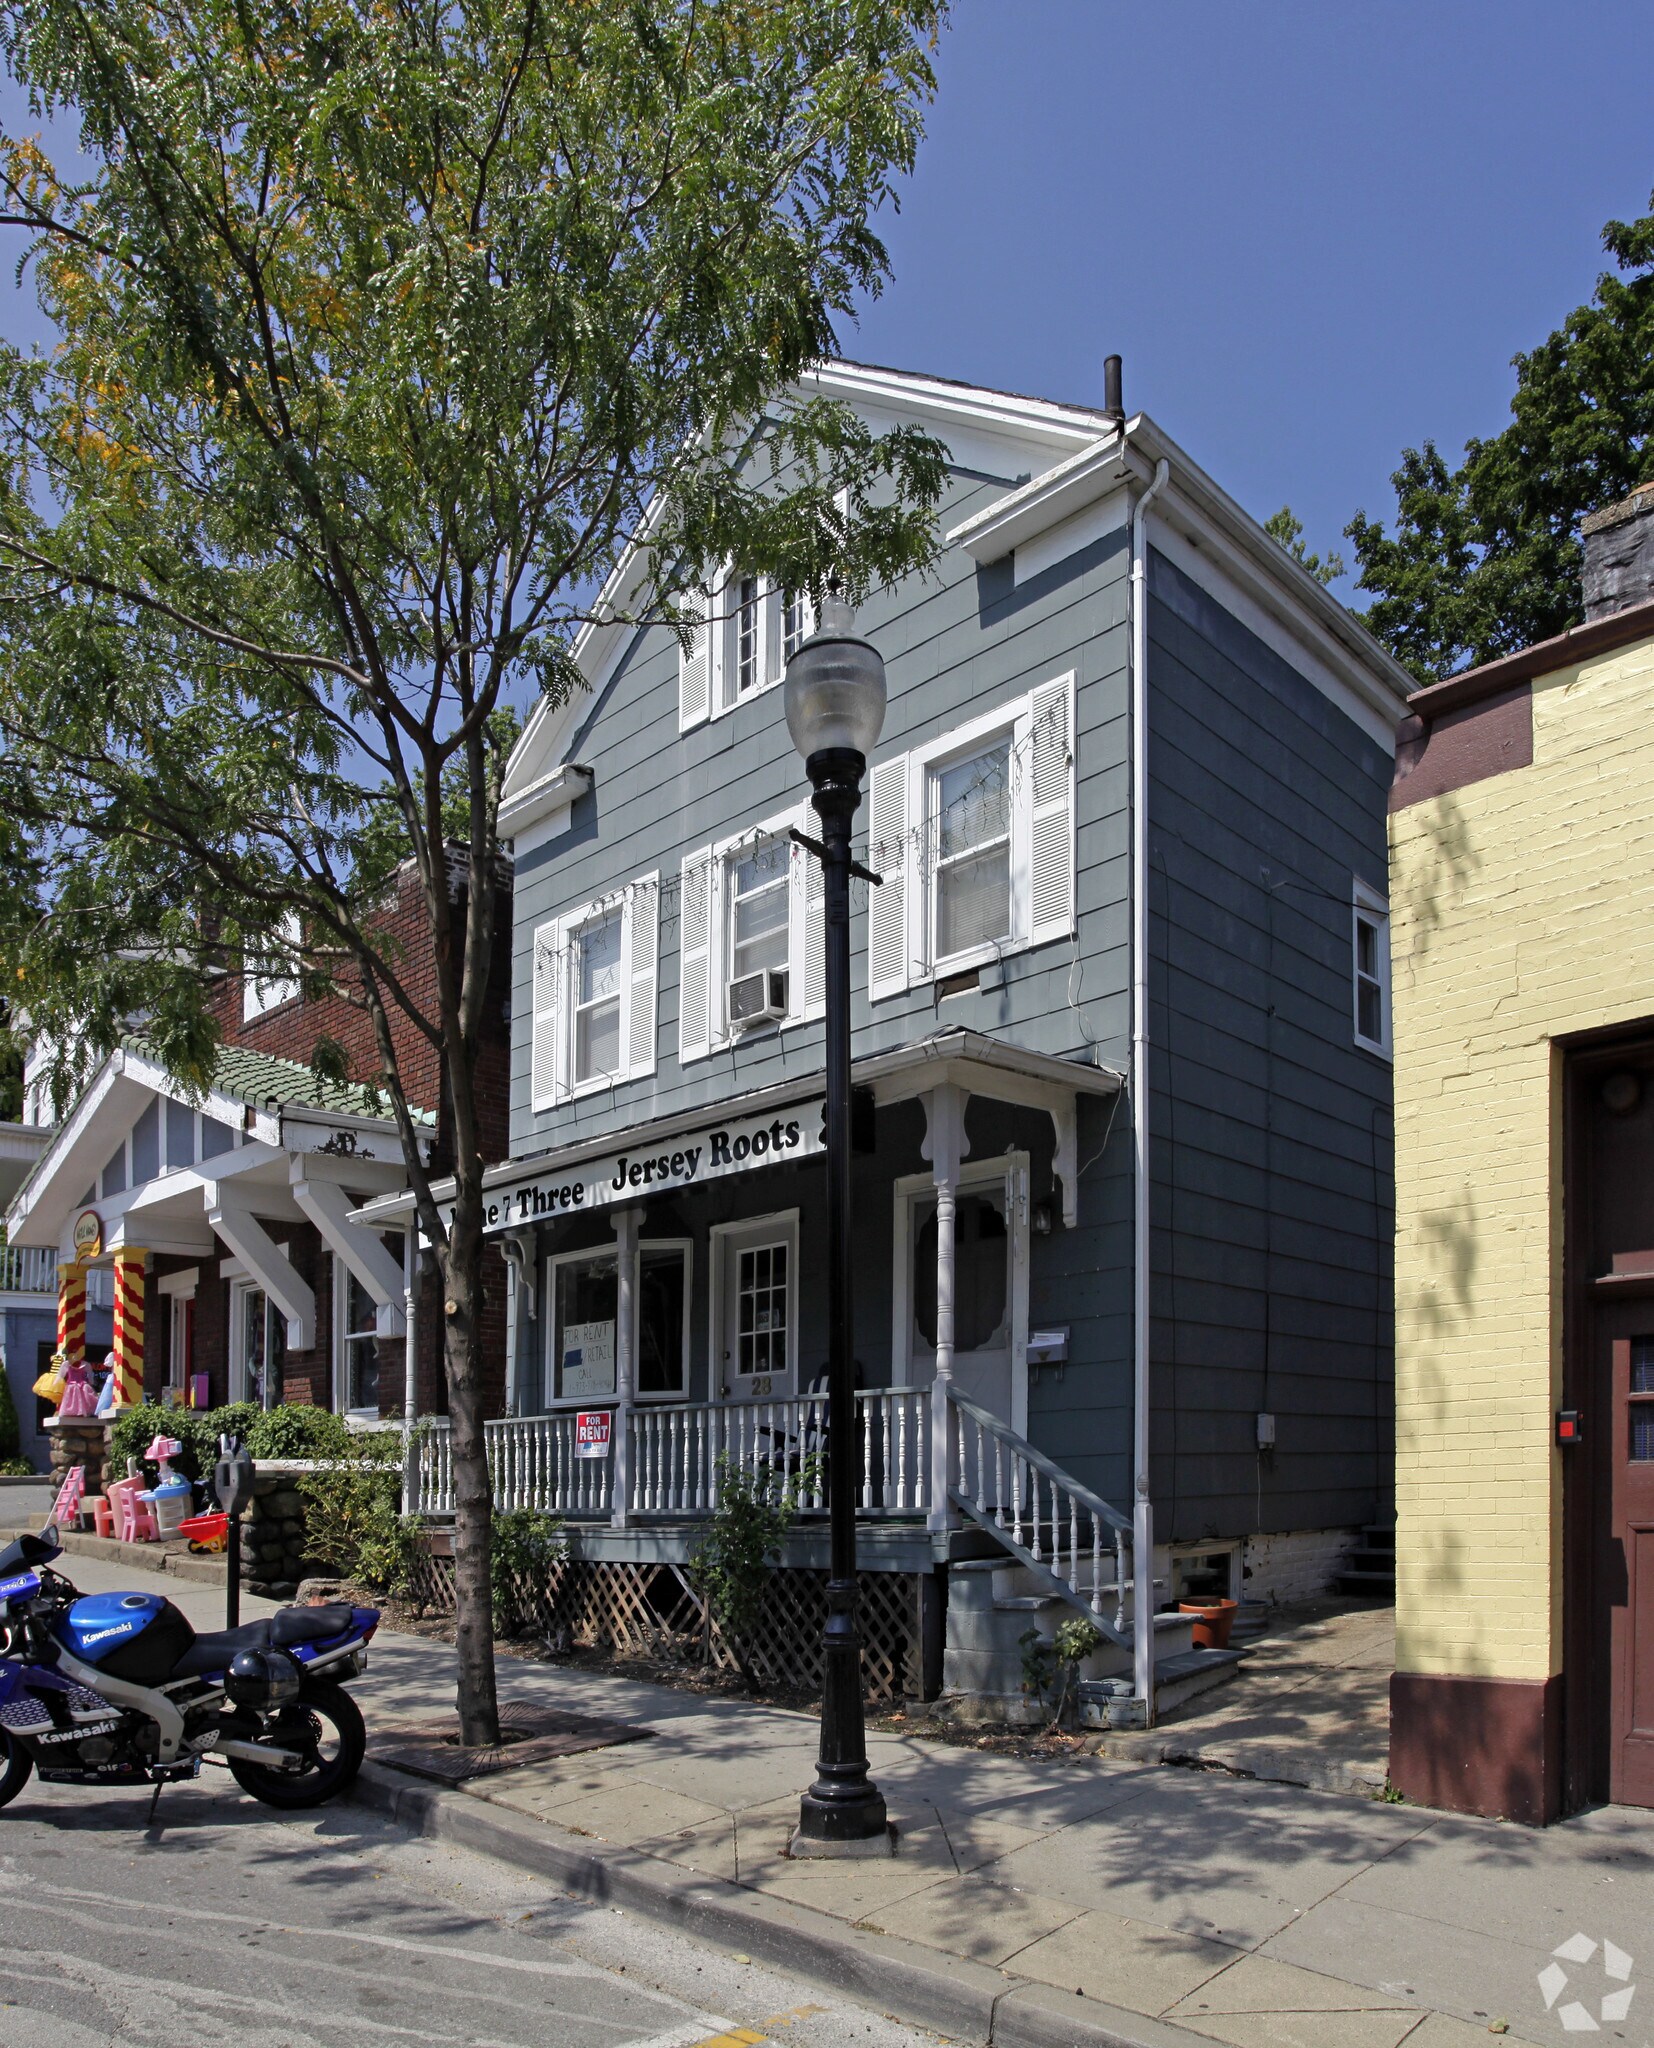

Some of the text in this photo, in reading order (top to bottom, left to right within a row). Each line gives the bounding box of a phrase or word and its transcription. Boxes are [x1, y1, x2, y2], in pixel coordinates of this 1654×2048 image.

[611, 1119, 800, 1191] Jersey Roots
[502, 1195, 511, 1222] 7
[516, 1182, 585, 1218] Three
[564, 1322, 610, 1344] FOR RENT
[578, 1367, 592, 1380] CALL
[752, 1376, 771, 1395] 28
[586, 1416, 601, 1426] FOR
[579, 1425, 608, 1441] RENT
[82, 1621, 133, 1645] Kawasaki
[37, 1720, 116, 1744] Kawasaki
